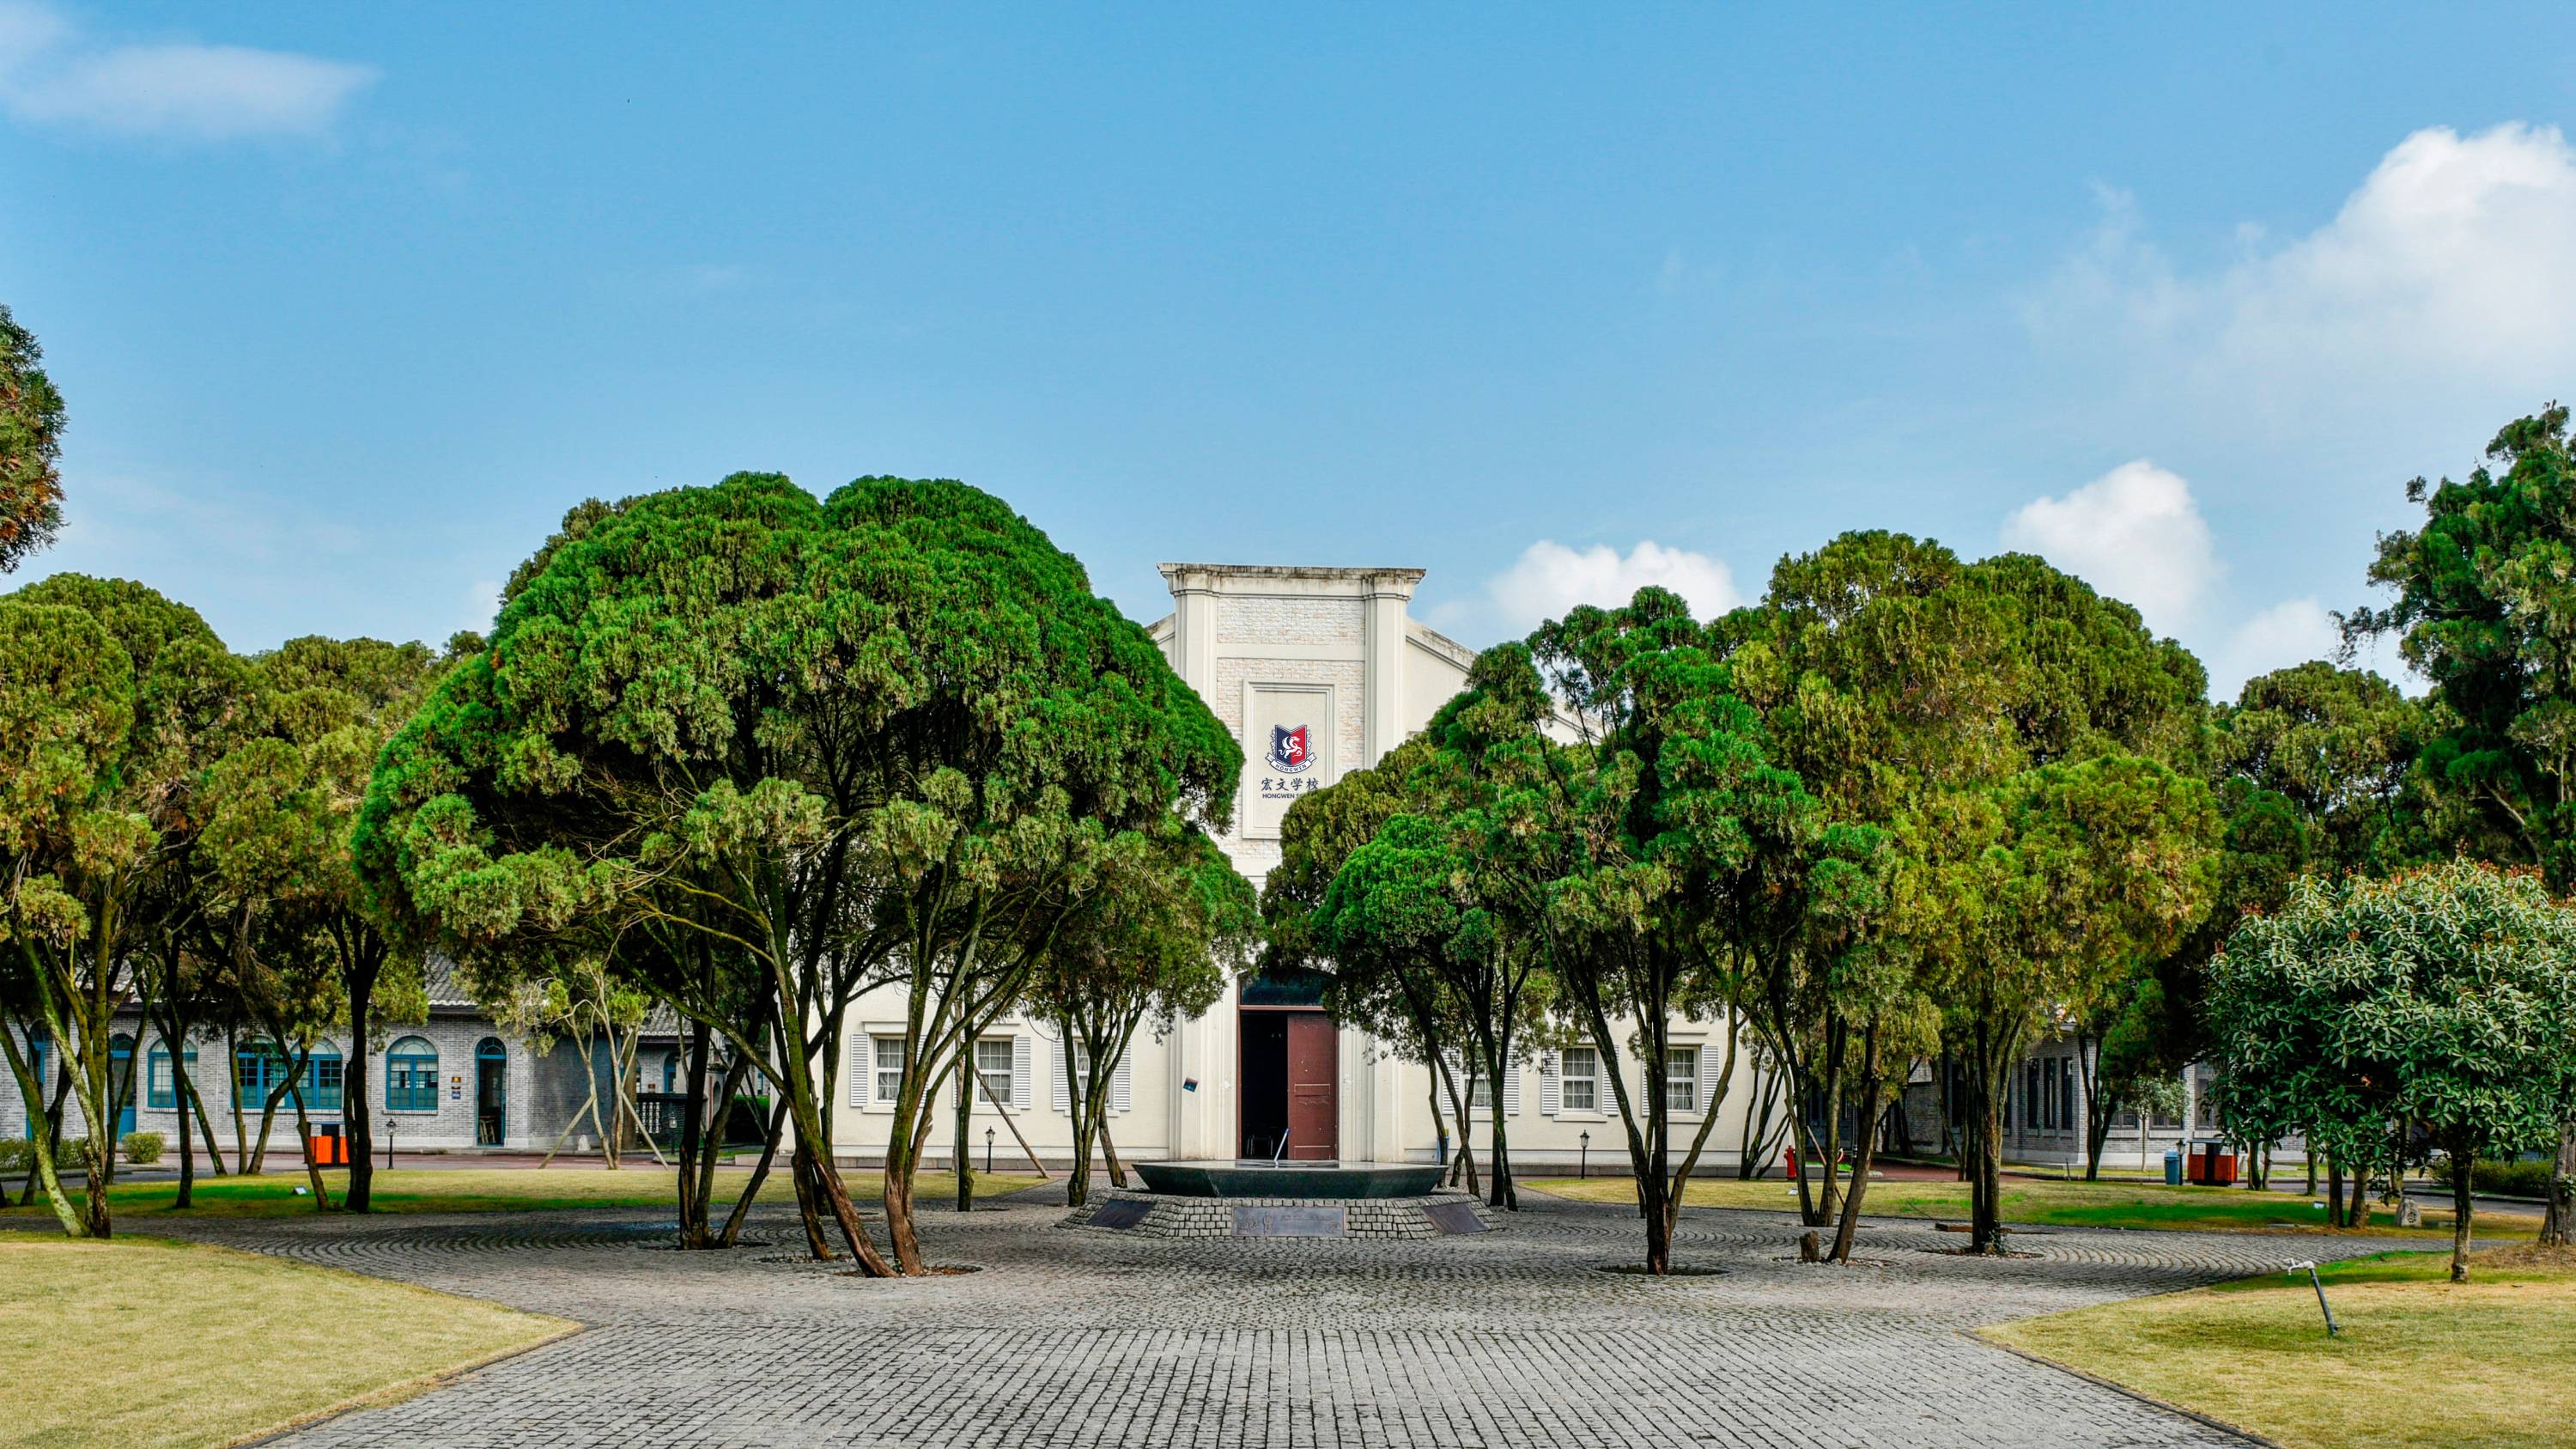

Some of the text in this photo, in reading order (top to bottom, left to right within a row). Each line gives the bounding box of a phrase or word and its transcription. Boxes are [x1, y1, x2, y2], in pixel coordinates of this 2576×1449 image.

[1275, 764, 1307, 772] HONGWEN
[1261, 777, 1319, 791] 宏文学校
